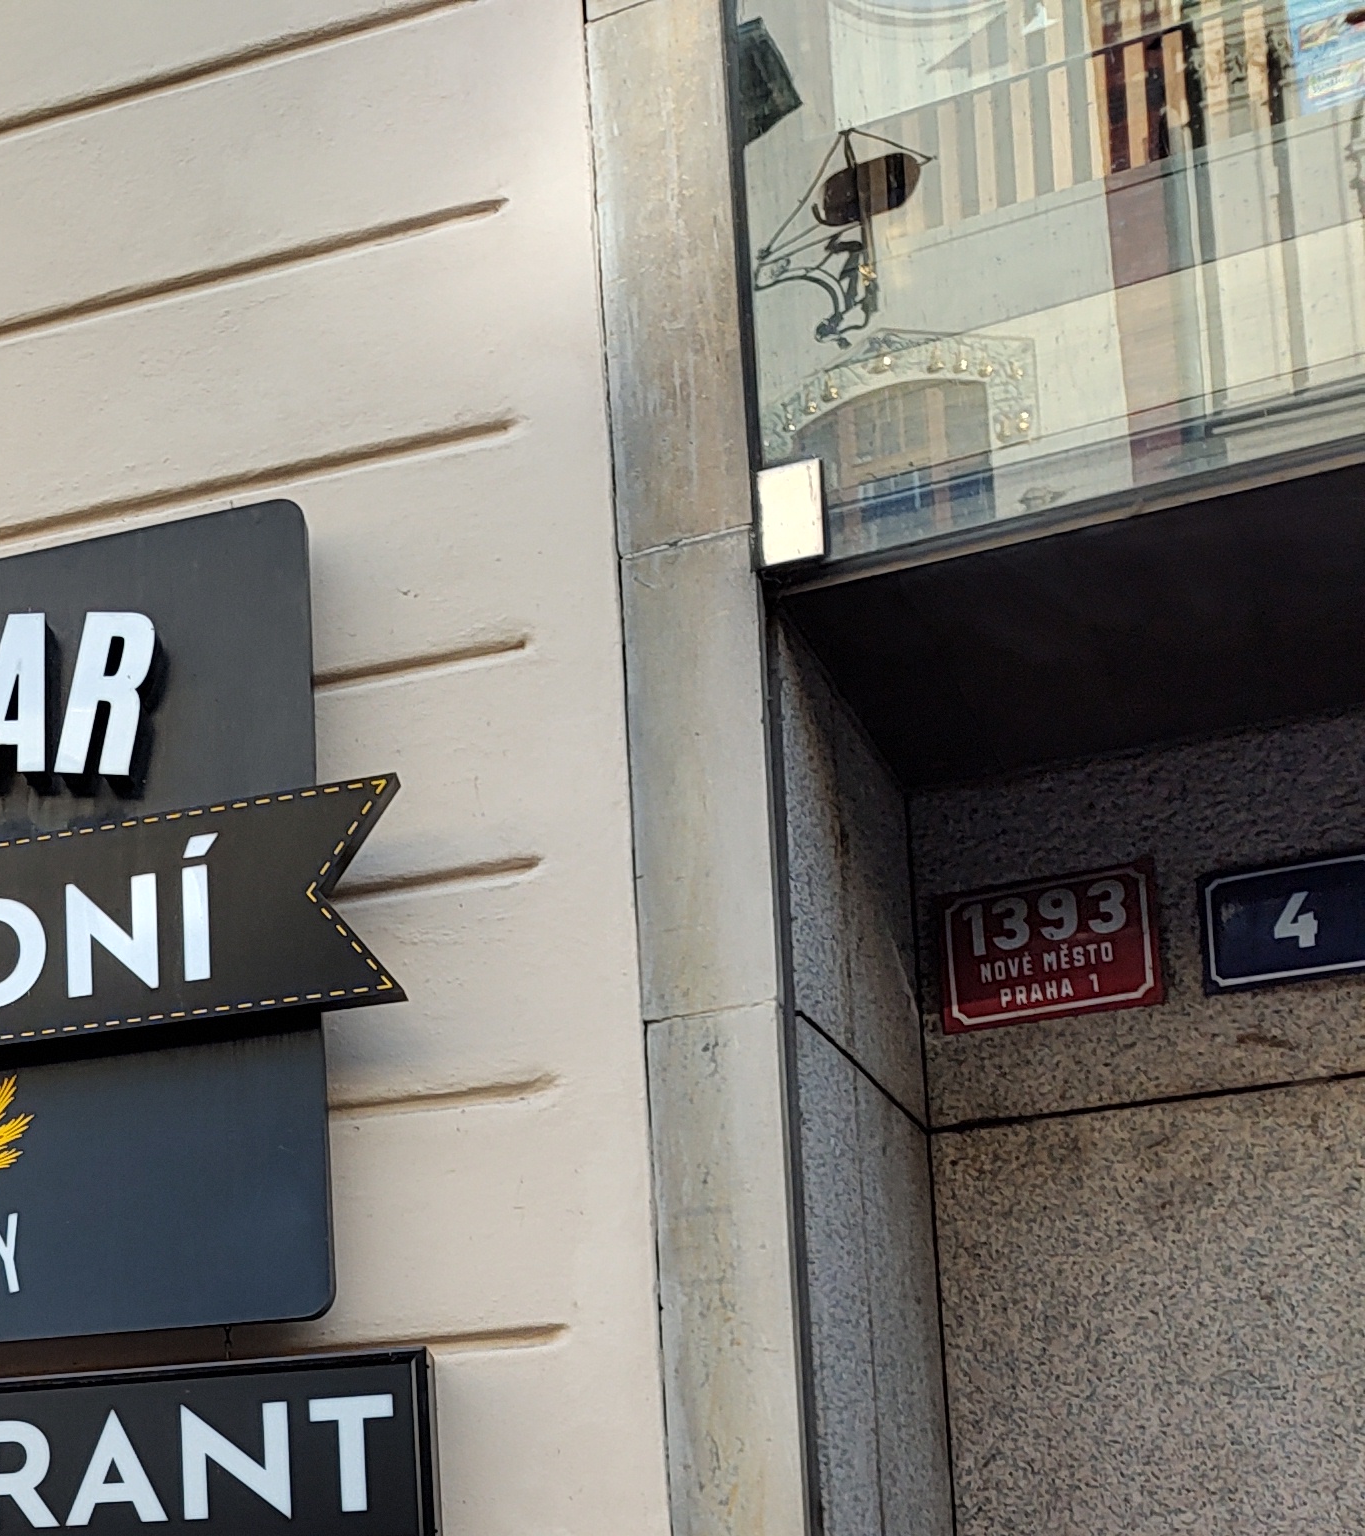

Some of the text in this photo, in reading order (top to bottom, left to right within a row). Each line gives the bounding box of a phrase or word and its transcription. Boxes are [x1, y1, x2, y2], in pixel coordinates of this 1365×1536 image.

[963, 879, 1127, 957] 1393
[1273, 891, 1319, 949] 4
[980, 941, 1114, 984] NOVÉ MĚSTO
[1000, 972, 1100, 1008] PRAHA 1
